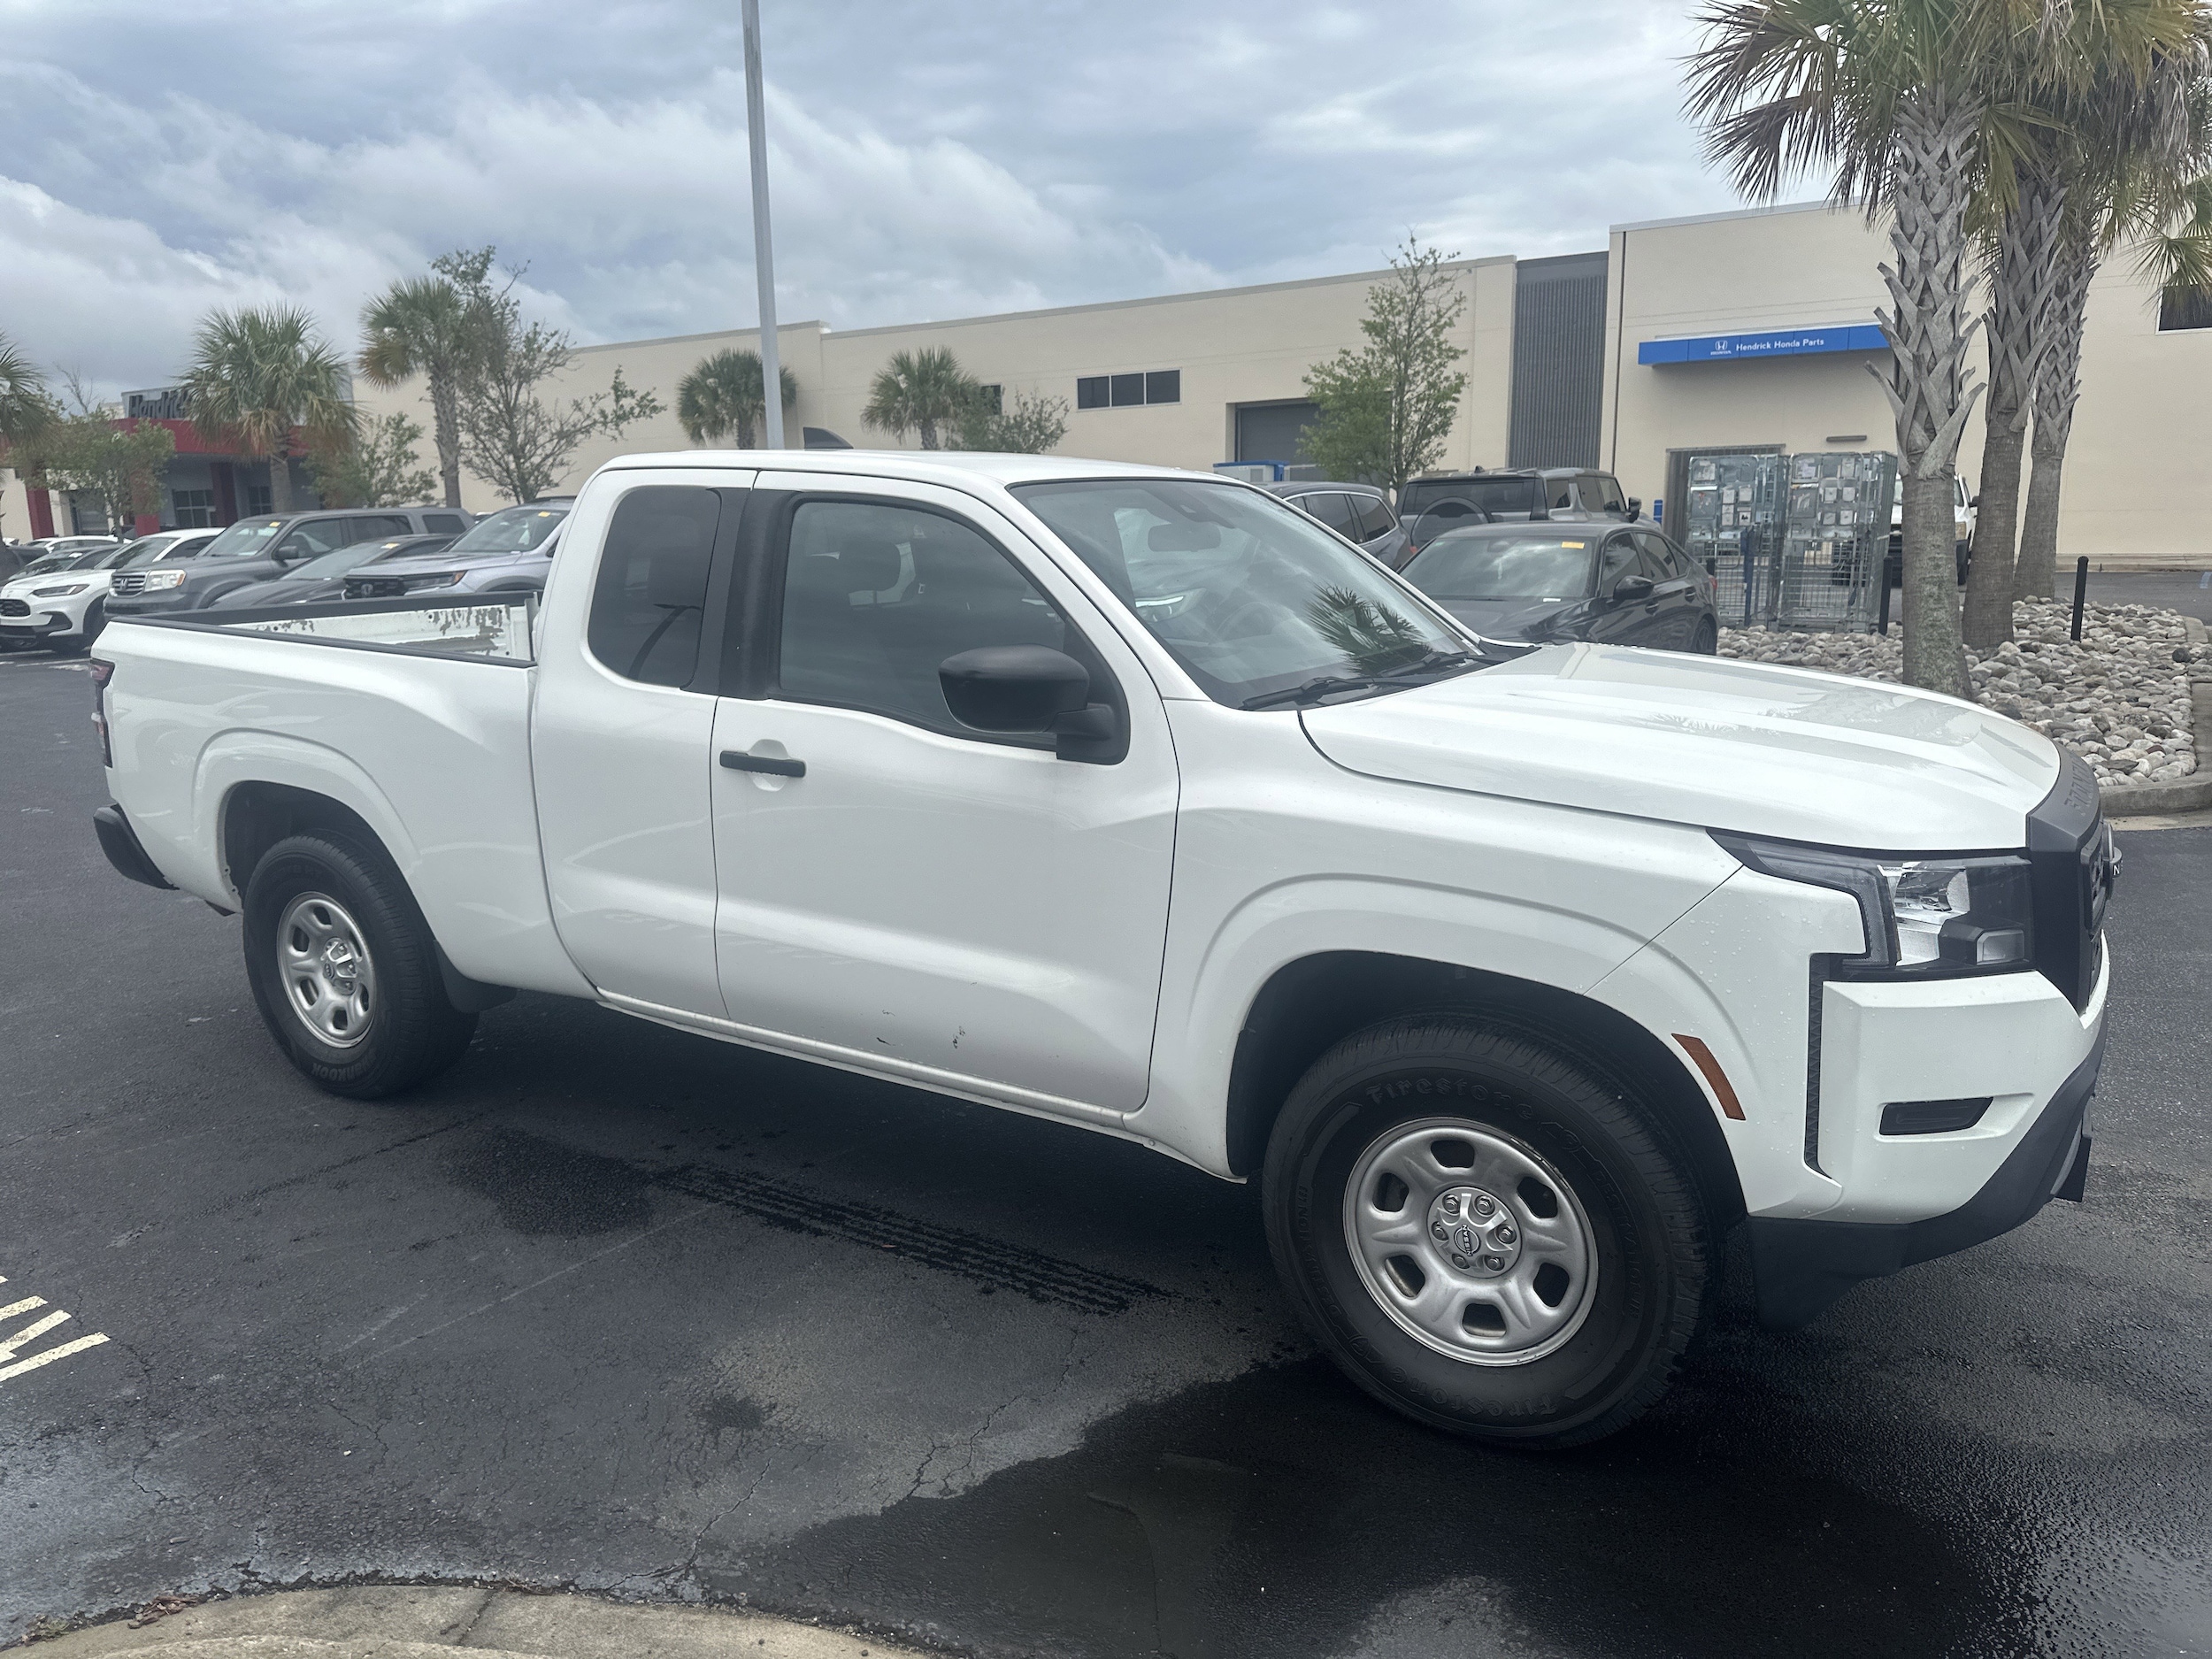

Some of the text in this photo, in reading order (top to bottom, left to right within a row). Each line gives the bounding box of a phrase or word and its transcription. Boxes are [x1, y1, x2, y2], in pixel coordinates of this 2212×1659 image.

[1736, 342, 1770, 351] Hendrick
[1774, 340, 1800, 349] Honda
[1365, 1076, 1533, 1121] Firestone
[1462, 1224, 1473, 1256] NISSAN
[1388, 1364, 1558, 1418] Firestone
